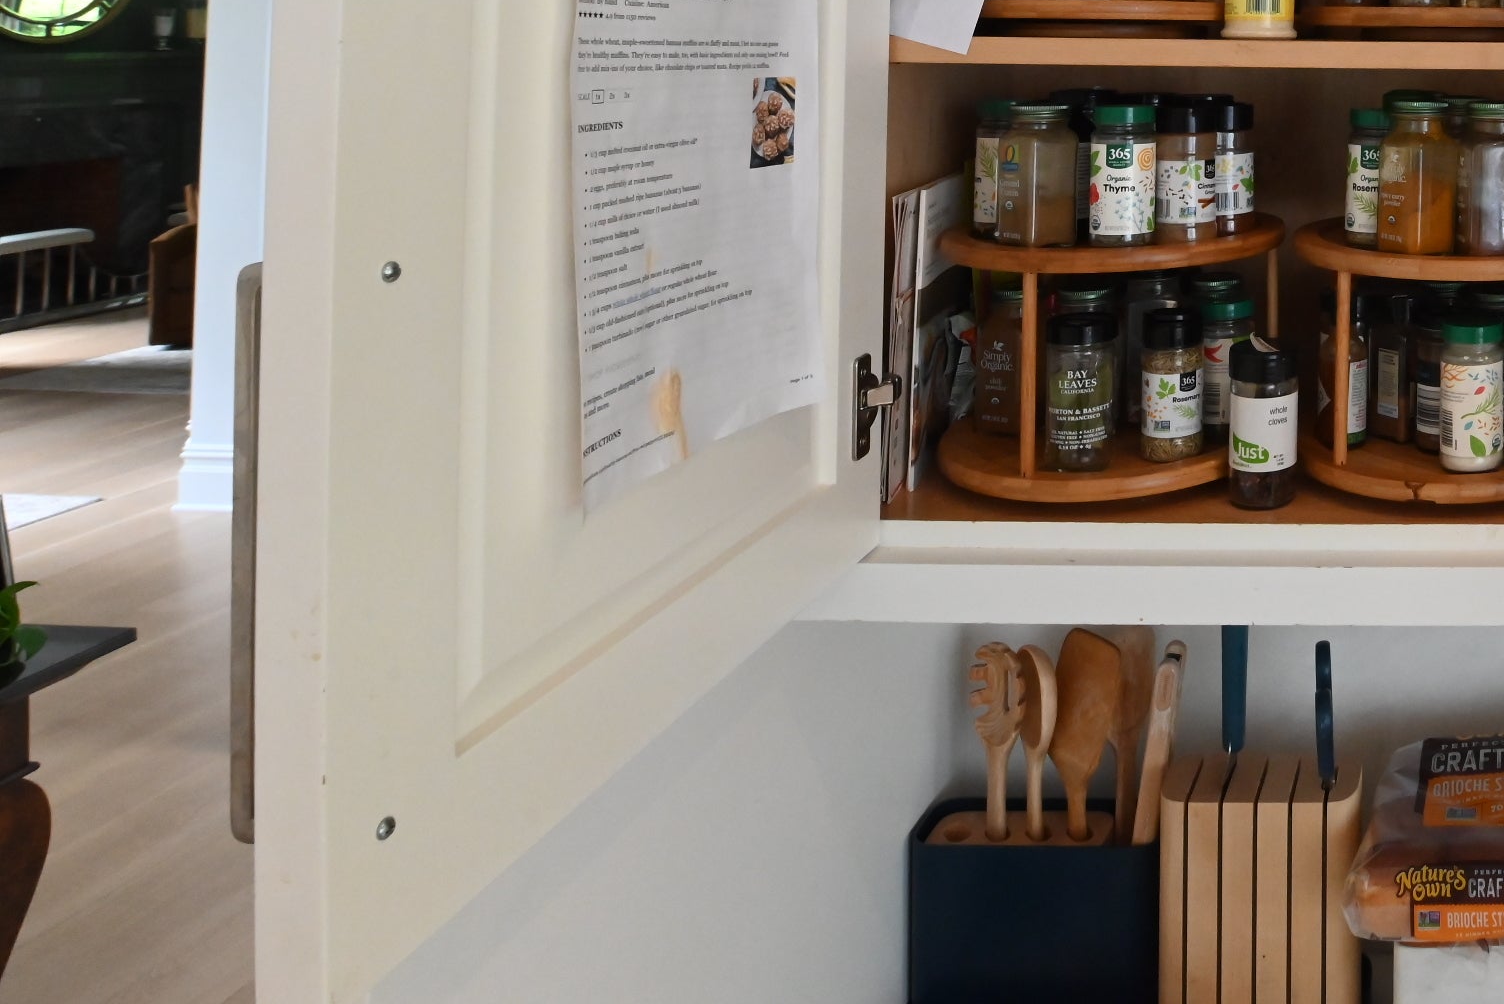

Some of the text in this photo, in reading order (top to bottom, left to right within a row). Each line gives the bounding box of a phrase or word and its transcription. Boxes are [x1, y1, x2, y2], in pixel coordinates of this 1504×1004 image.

[577, 121, 624, 134] INGREDIENTS
[1108, 147, 1131, 161] 365
[1106, 174, 1132, 183] Organic
[1103, 183, 1136, 194] Thyme
[1352, 182, 1379, 193] Rosem
[983, 350, 1012, 364] Simply
[981, 359, 1013, 372] Organic
[1067, 370, 1088, 379] BAY
[1058, 378, 1098, 389] LEAVES
[1182, 375, 1196, 386] 365
[1083, 402, 1110, 414] BASSETT
[1269, 406, 1288, 415] whole
[1067, 412, 1101, 421] FRANCISCO
[1268, 416, 1288, 426] cloves
[1237, 442, 1265, 459] Just
[1433, 777, 1490, 797] BRIOCHE
[1412, 882, 1452, 902] Own
[1446, 910, 1490, 929] BRIOCHE
